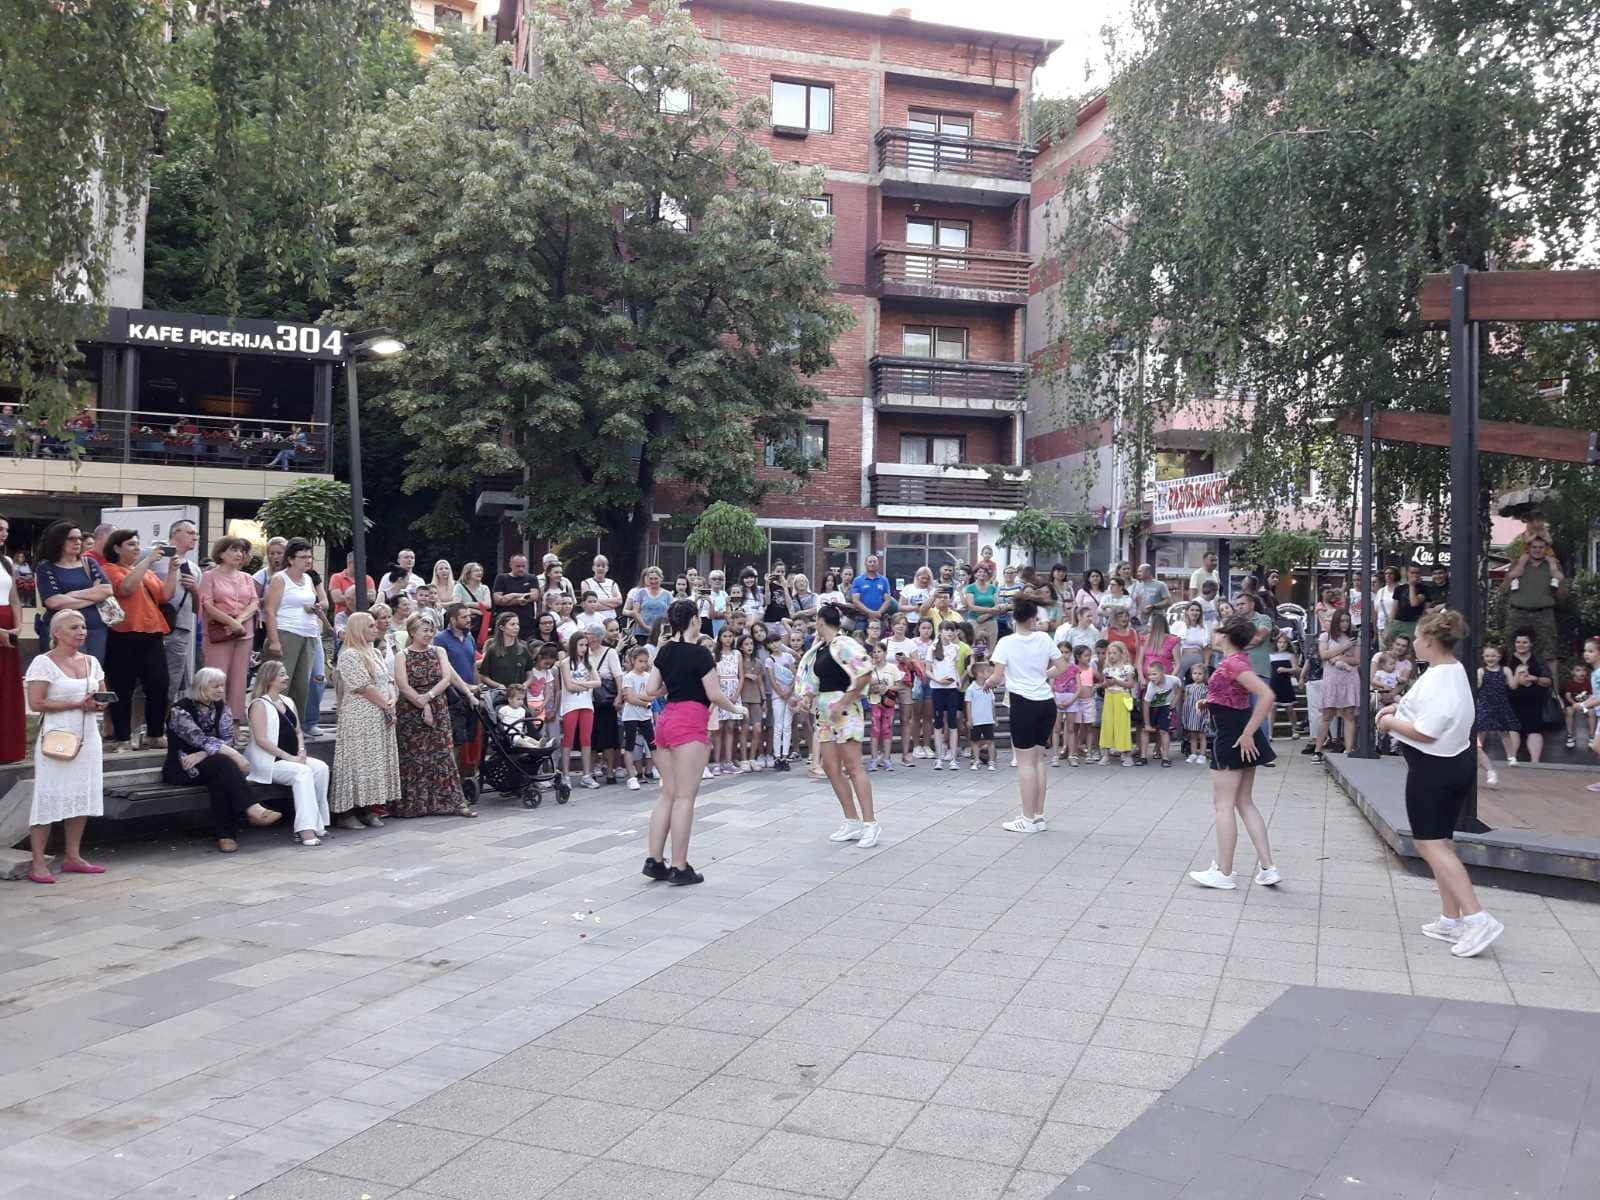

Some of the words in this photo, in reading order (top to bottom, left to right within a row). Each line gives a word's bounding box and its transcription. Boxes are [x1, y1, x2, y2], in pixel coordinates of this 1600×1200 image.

[129, 323, 184, 343] KAFE
[190, 328, 274, 350] PICERIJA
[276, 325, 343, 355] 304
